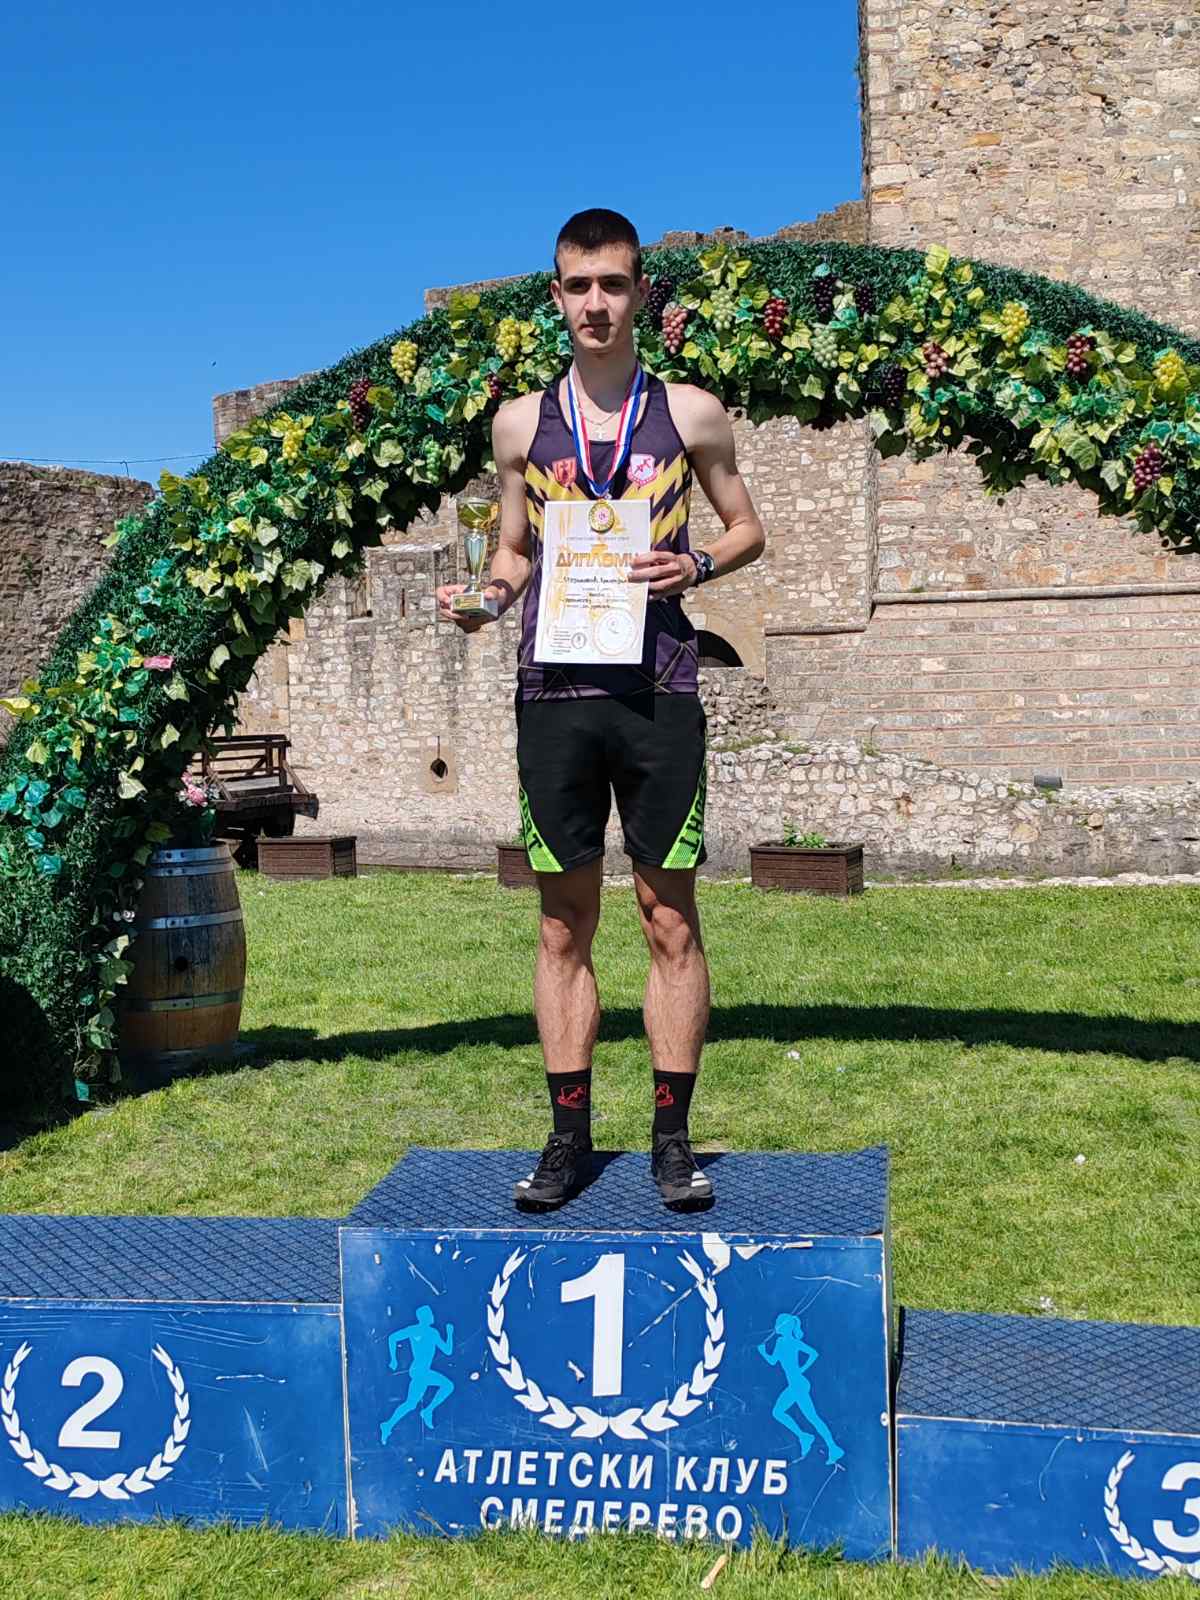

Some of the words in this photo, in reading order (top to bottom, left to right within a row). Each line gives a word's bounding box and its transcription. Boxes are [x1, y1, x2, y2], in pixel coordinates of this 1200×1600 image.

[555, 551, 640, 568] ДИПЛОМ
[560, 1253, 625, 1397] 1
[59, 1357, 123, 1448] 2
[435, 1450, 652, 1488] АТЛЕТСКИ
[676, 1457, 786, 1494] КЛУБ
[480, 1496, 743, 1539] СМЕДЕРЕВО
[1154, 1463, 1200, 1552] 3
